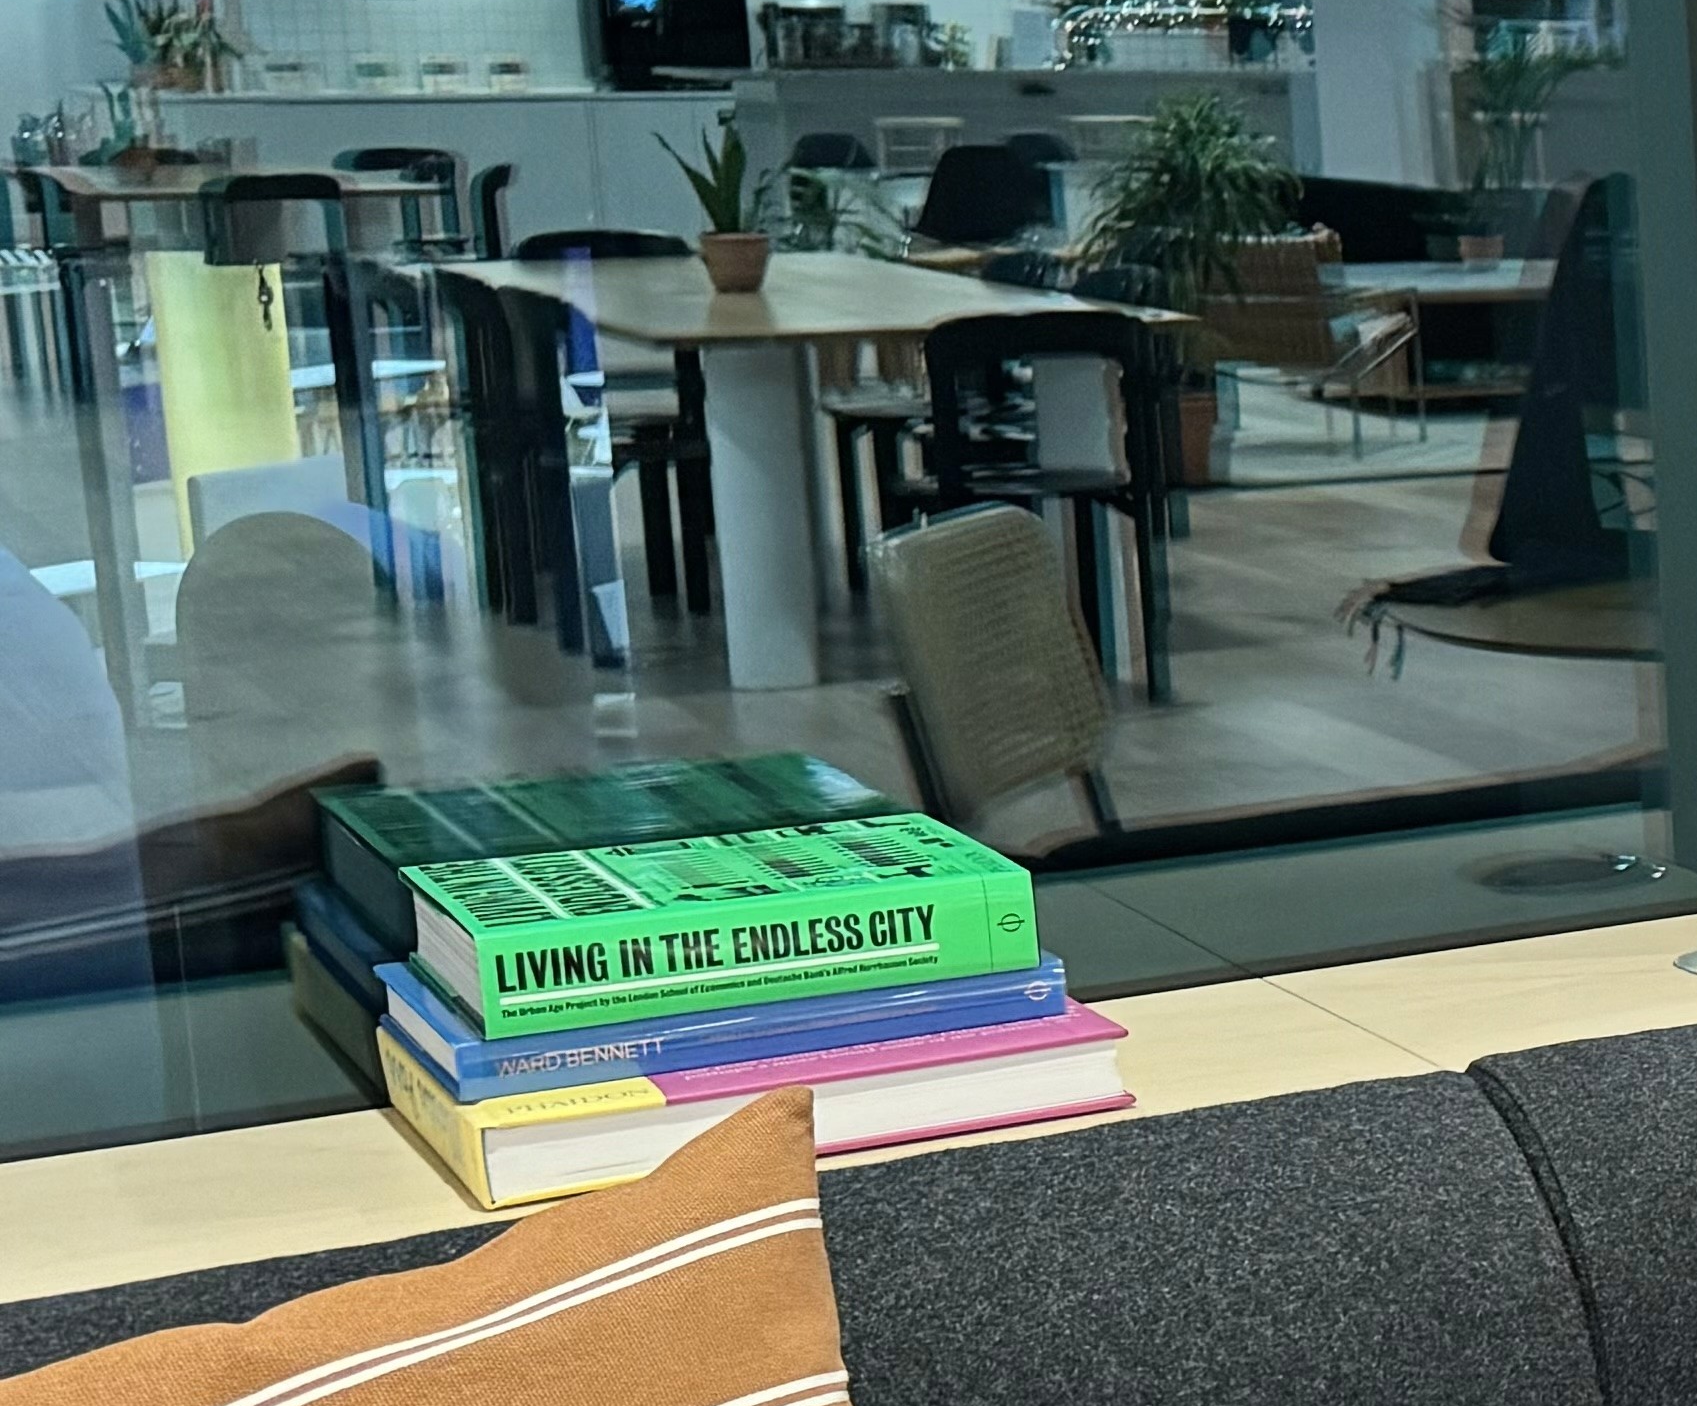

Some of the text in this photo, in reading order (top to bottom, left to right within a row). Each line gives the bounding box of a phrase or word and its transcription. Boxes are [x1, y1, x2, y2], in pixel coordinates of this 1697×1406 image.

[496, 904, 935, 994] LIVING IN THE ENDLESS CITY
[501, 1009, 518, 1019] The
[519, 1005, 547, 1017] Urban
[548, 1002, 564, 1014] Age
[565, 998, 599, 1012] Project
[600, 996, 611, 1008] by
[612, 994, 627, 1005] the
[628, 990, 659, 1003] London
[660, 987, 689, 999] School
[690, 984, 700, 996] of
[747, 977, 763, 989] and
[764, 972, 802, 986] Deutsche
[803, 968, 832, 981] Bank's
[832, 964, 859, 977] Alfred
[908, 954, 939, 969] Society
[499, 1037, 665, 1079] WARD BENNETT
[507, 1087, 649, 1115] PHAIDON
